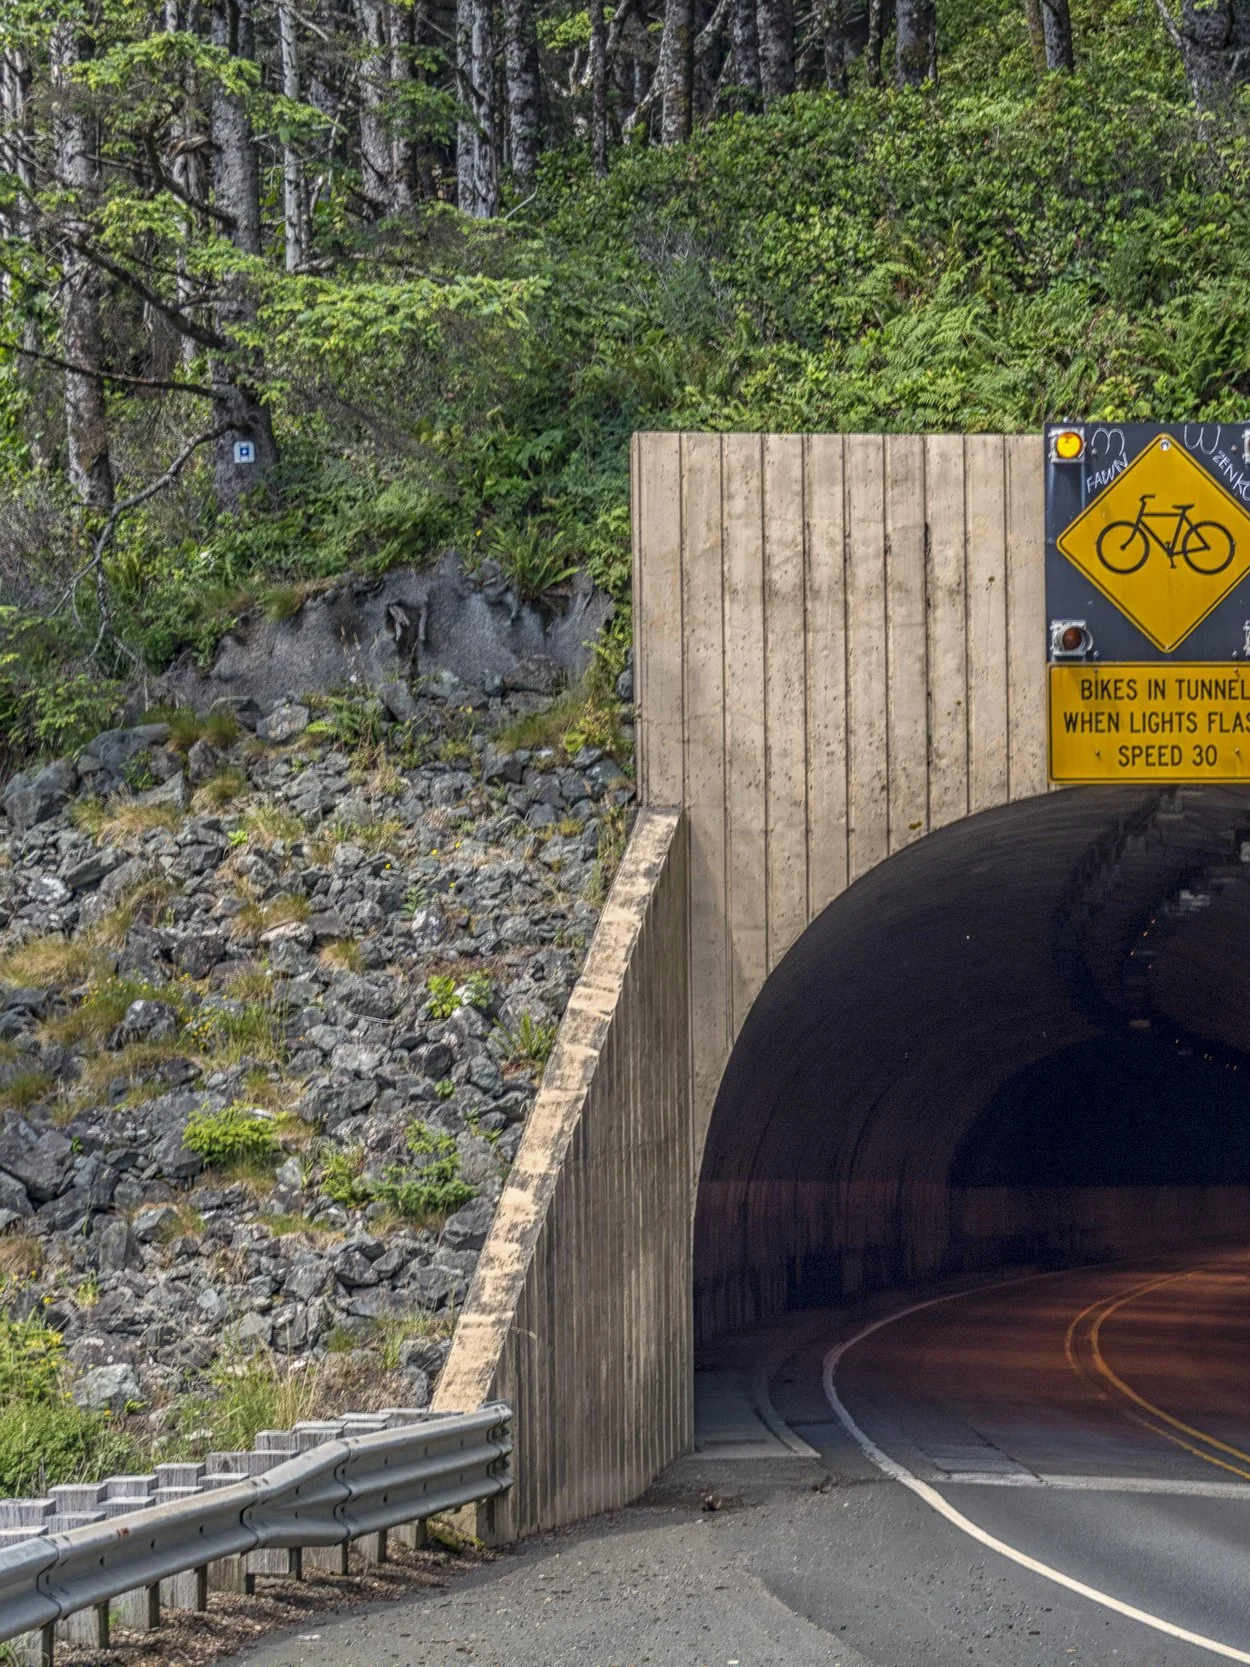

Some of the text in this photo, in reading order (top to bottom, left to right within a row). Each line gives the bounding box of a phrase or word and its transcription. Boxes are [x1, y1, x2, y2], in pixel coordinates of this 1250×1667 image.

[1081, 679, 1138, 700] BIKES
[1147, 679, 1166, 700] IN
[1063, 711, 1120, 733] WHEN
[1129, 711, 1198, 733] LIGHTS
[1118, 744, 1218, 767] SPEED 30
